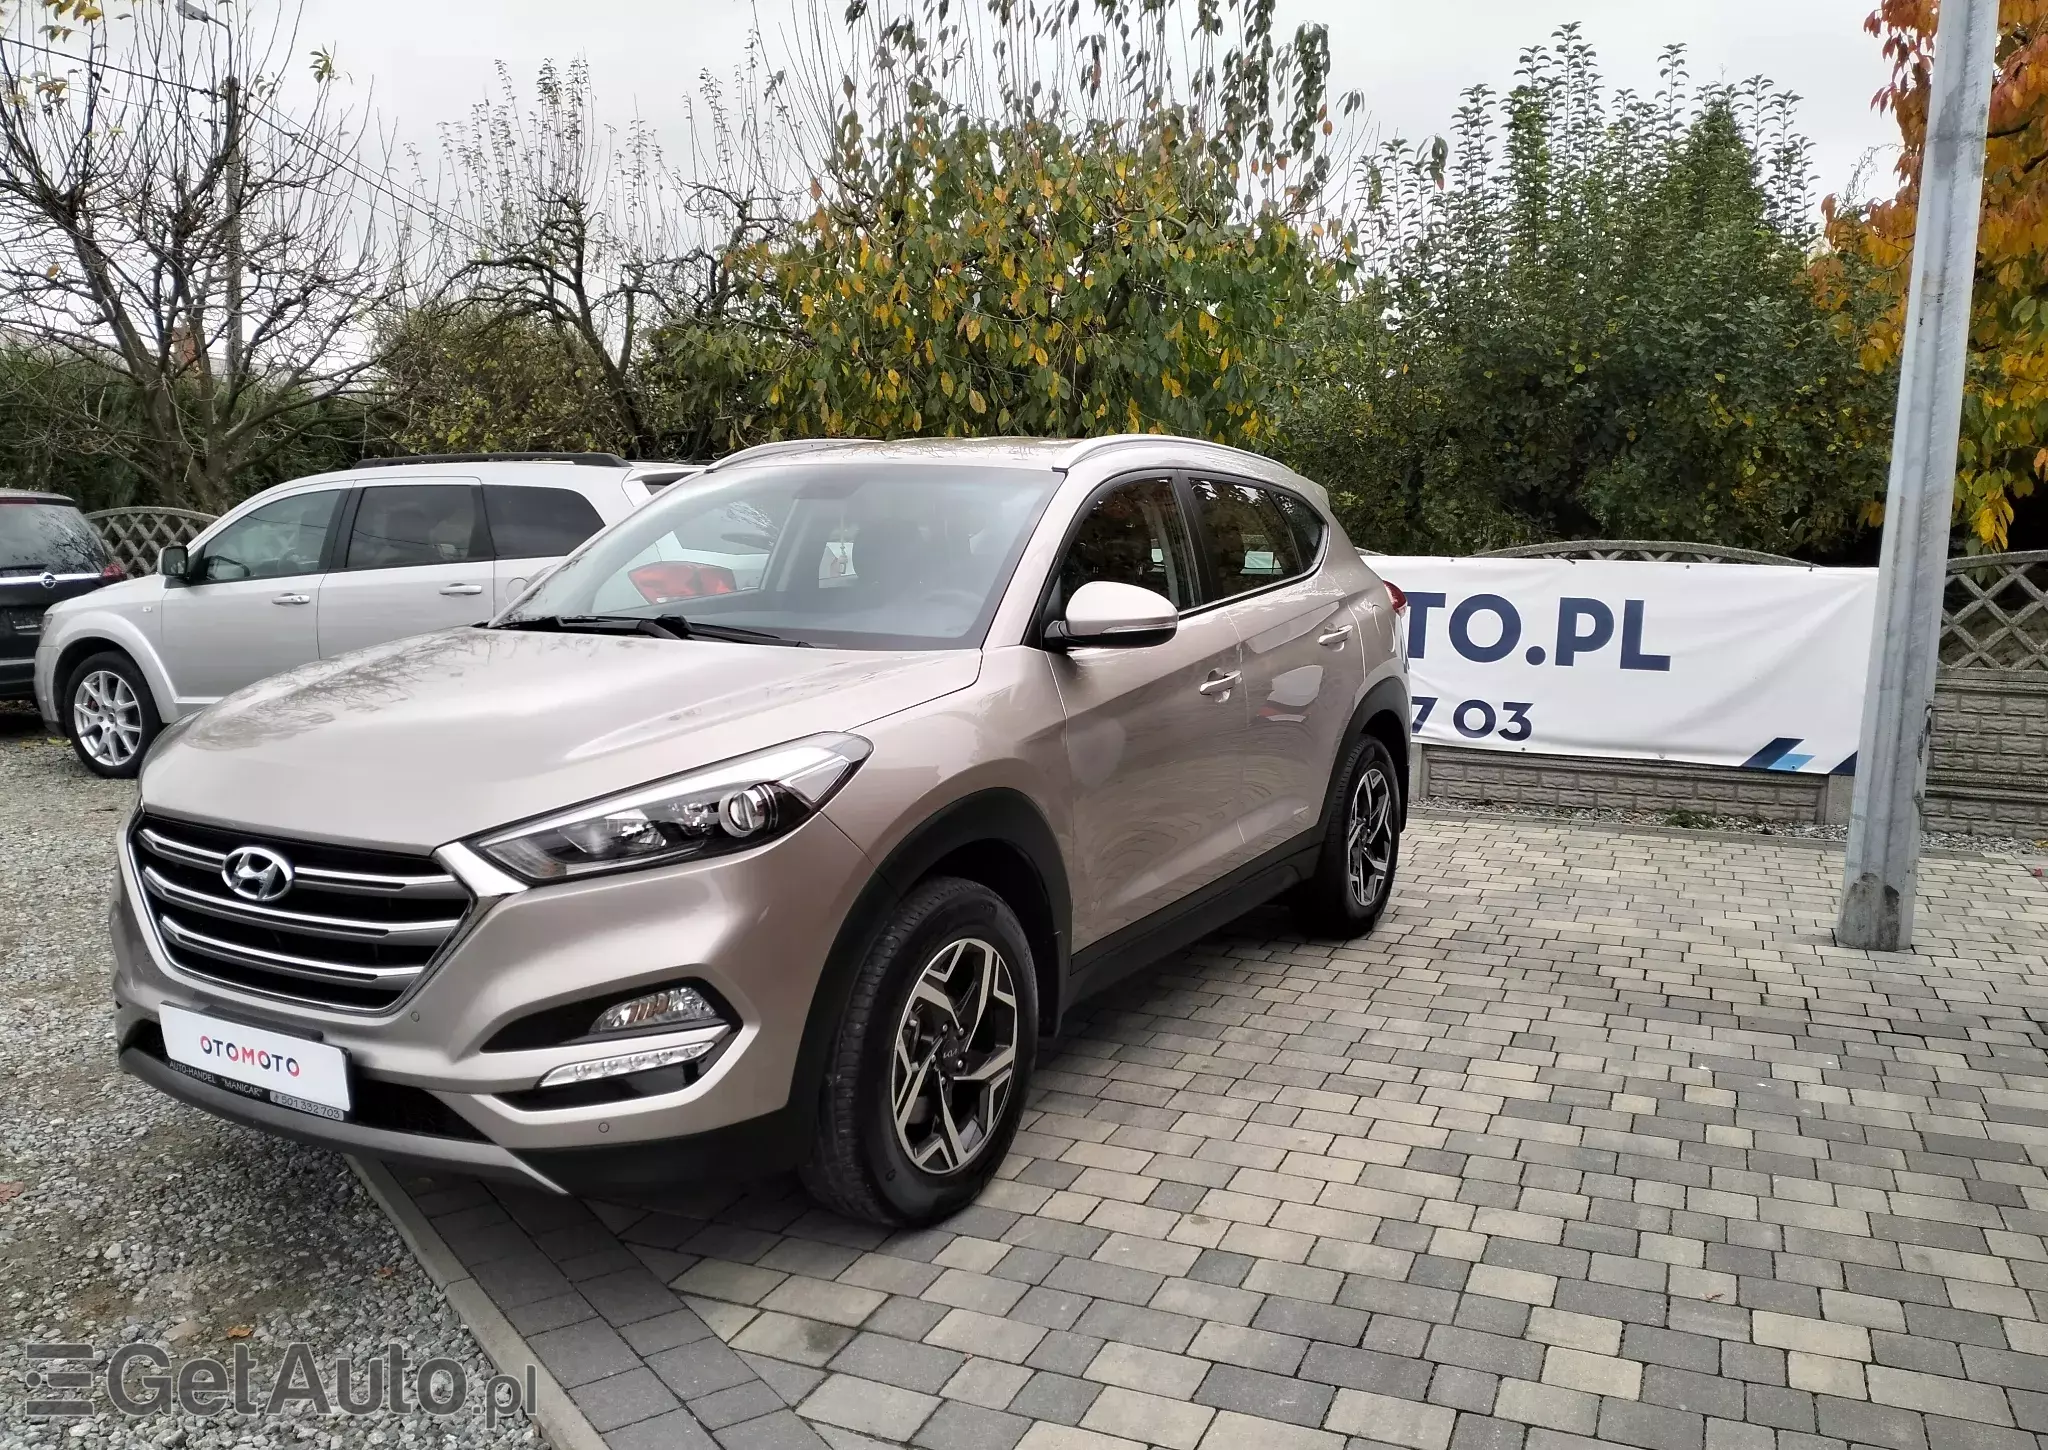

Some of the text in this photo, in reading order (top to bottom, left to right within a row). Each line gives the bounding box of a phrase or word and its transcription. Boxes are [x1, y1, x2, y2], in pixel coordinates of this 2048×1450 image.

[1402, 591, 1671, 672] TO.PL
[169, 1060, 217, 1084] AUTO-HANDEL
[200, 1034, 300, 1078] OTOMOTO
[281, 1095, 340, 1119] 501 332 703
